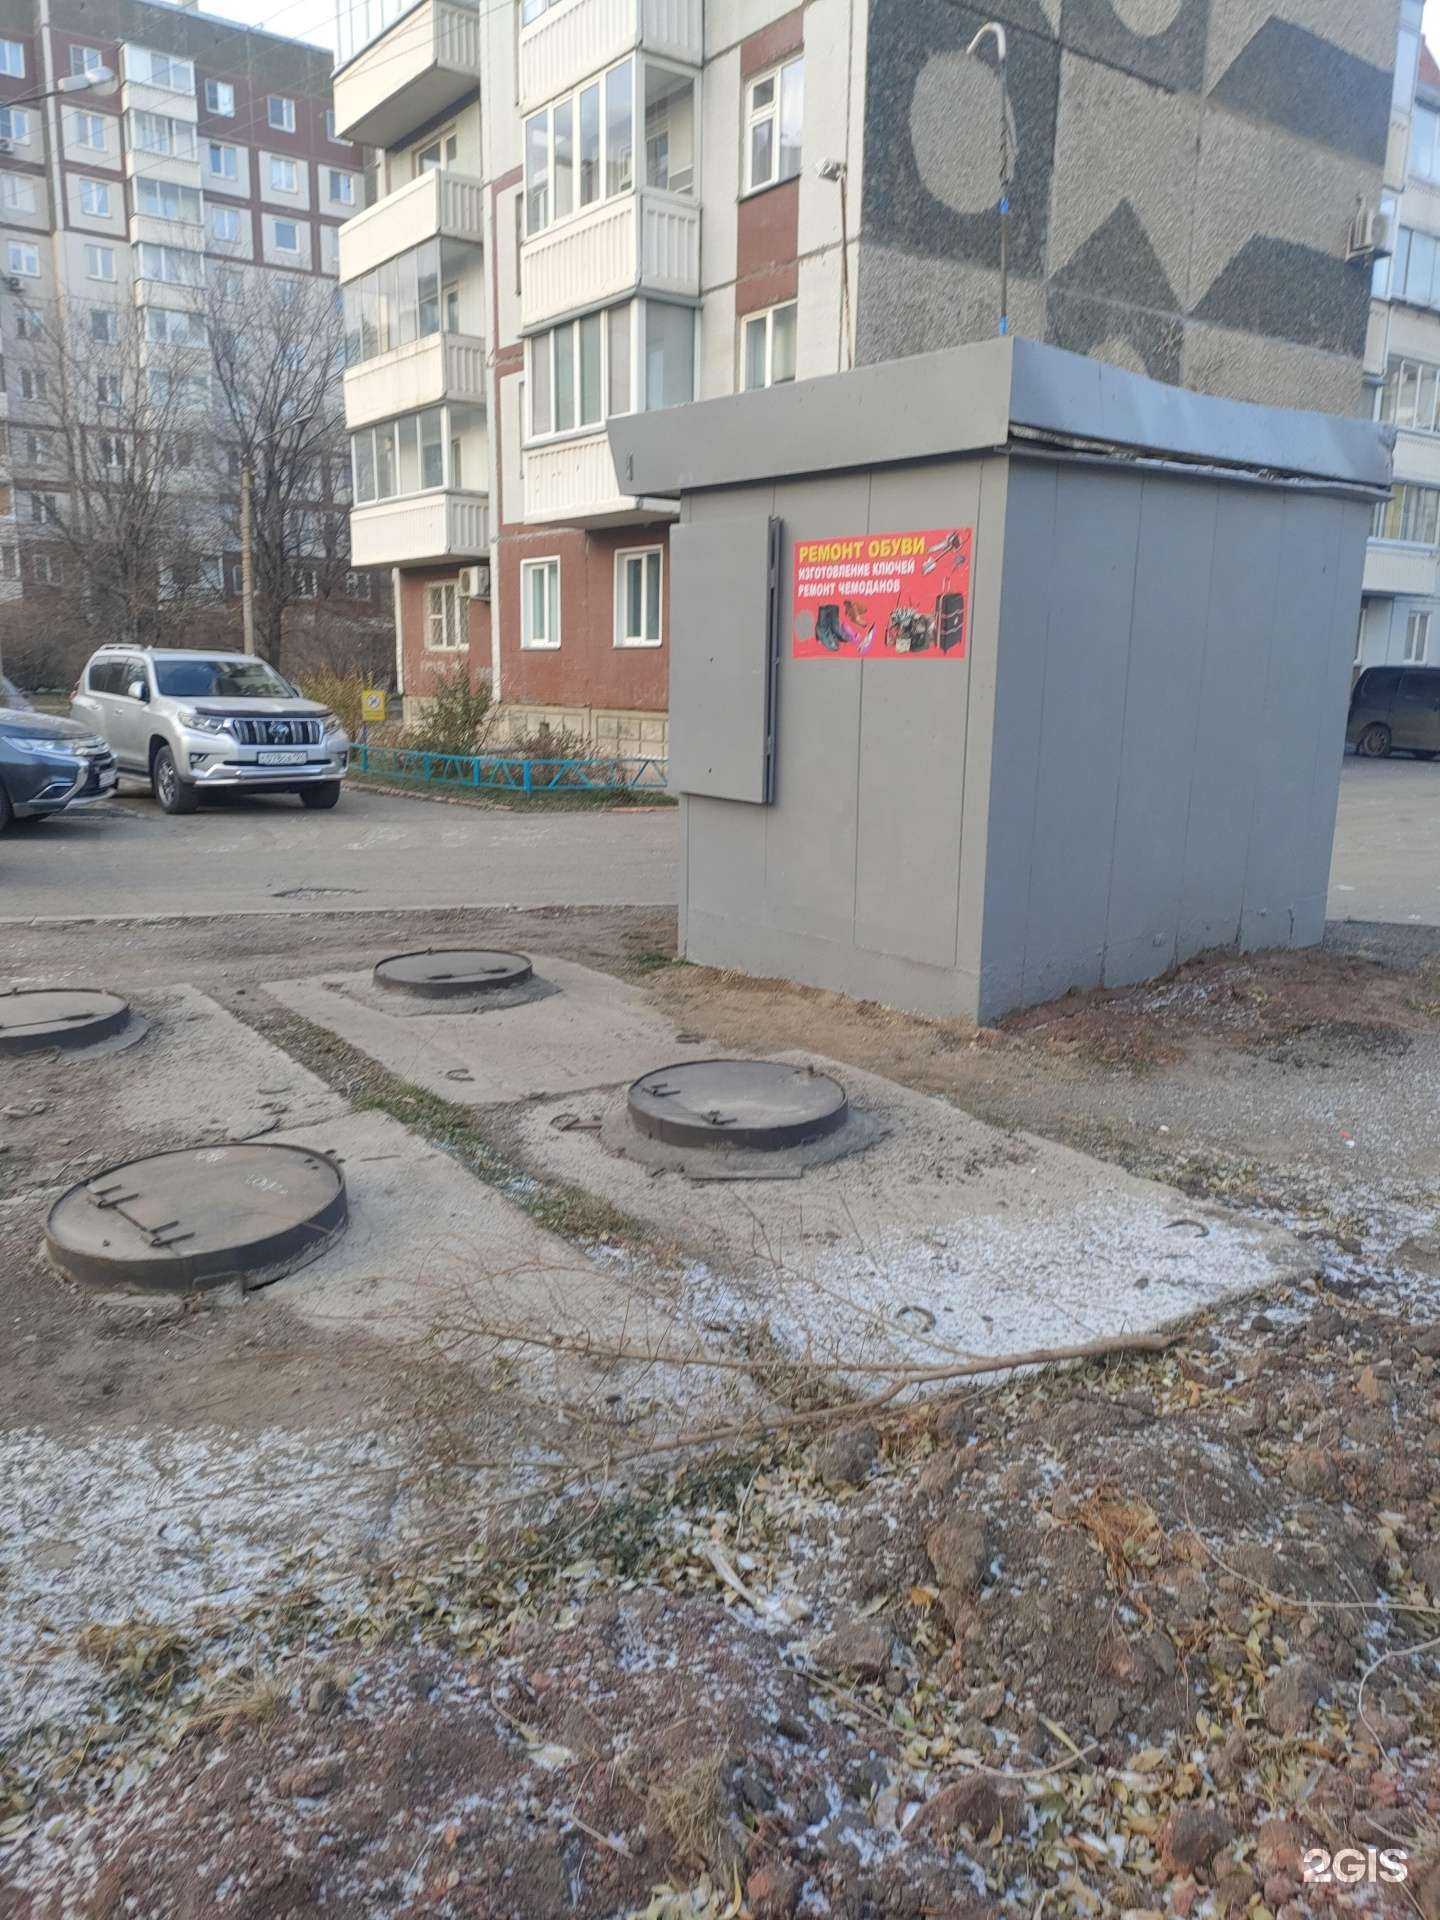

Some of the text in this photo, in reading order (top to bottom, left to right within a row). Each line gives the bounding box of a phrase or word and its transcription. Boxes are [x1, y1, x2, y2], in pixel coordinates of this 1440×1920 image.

[799, 536, 926, 562] РЕМОНТ ОБУВИ
[798, 558, 915, 580] ИЗГОТОВЛЕНИЕ КЛЮЧЕЙ
[798, 579, 900, 597] РЕМОНТ ЧЕМОДАНОВ
